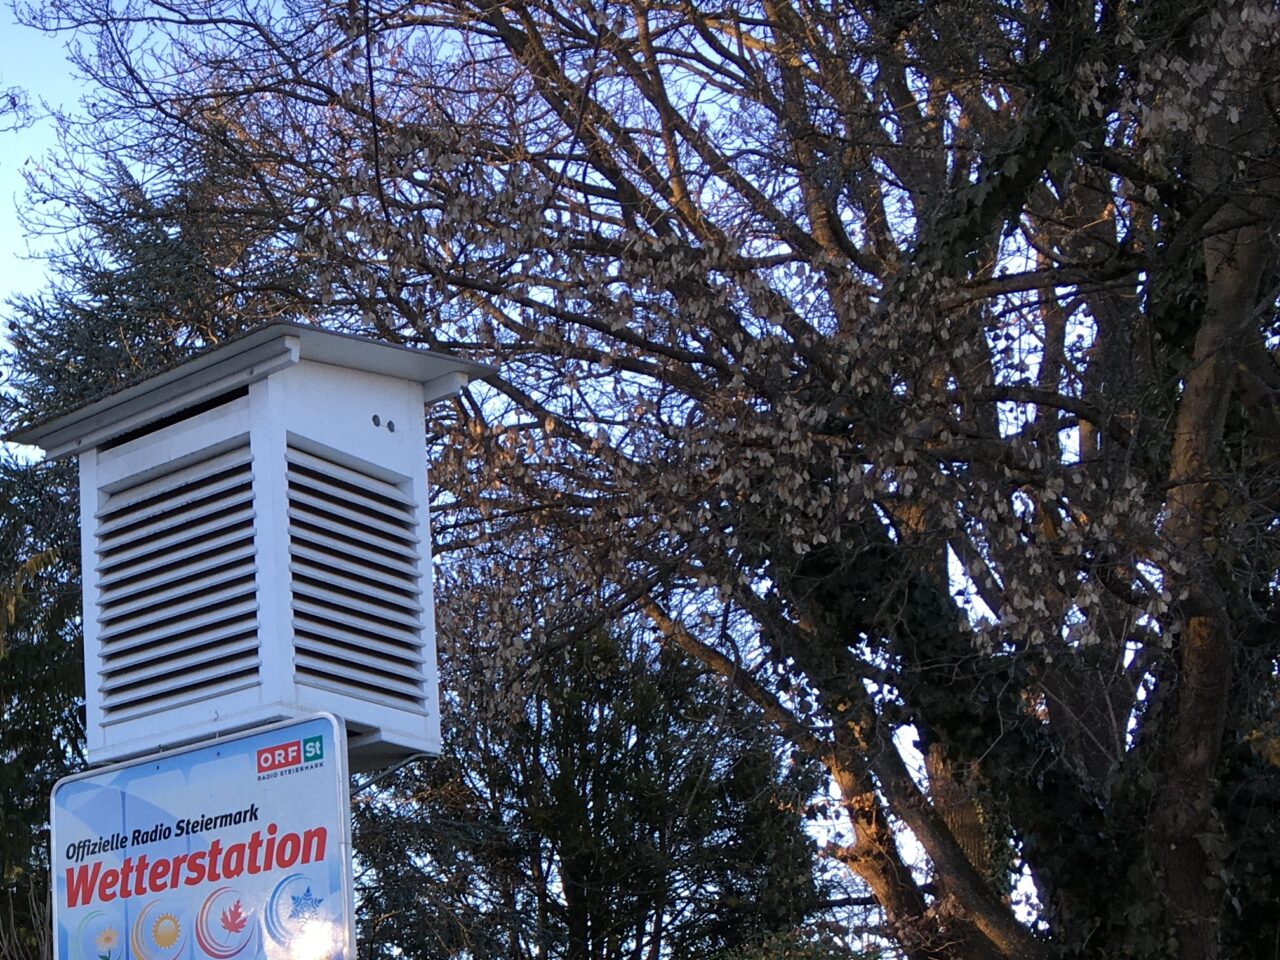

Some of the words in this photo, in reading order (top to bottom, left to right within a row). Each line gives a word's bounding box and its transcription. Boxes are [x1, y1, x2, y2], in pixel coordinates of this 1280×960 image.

[257, 772, 278, 782] RADIO
[280, 762, 324, 776] STEIERMARK
[260, 746, 298, 768] ORF
[305, 740, 321, 757] St
[65, 833, 128, 863] Offizielle
[131, 823, 172, 847] Radio
[175, 803, 259, 836] Steiermark
[65, 822, 327, 908] Wetterstation
